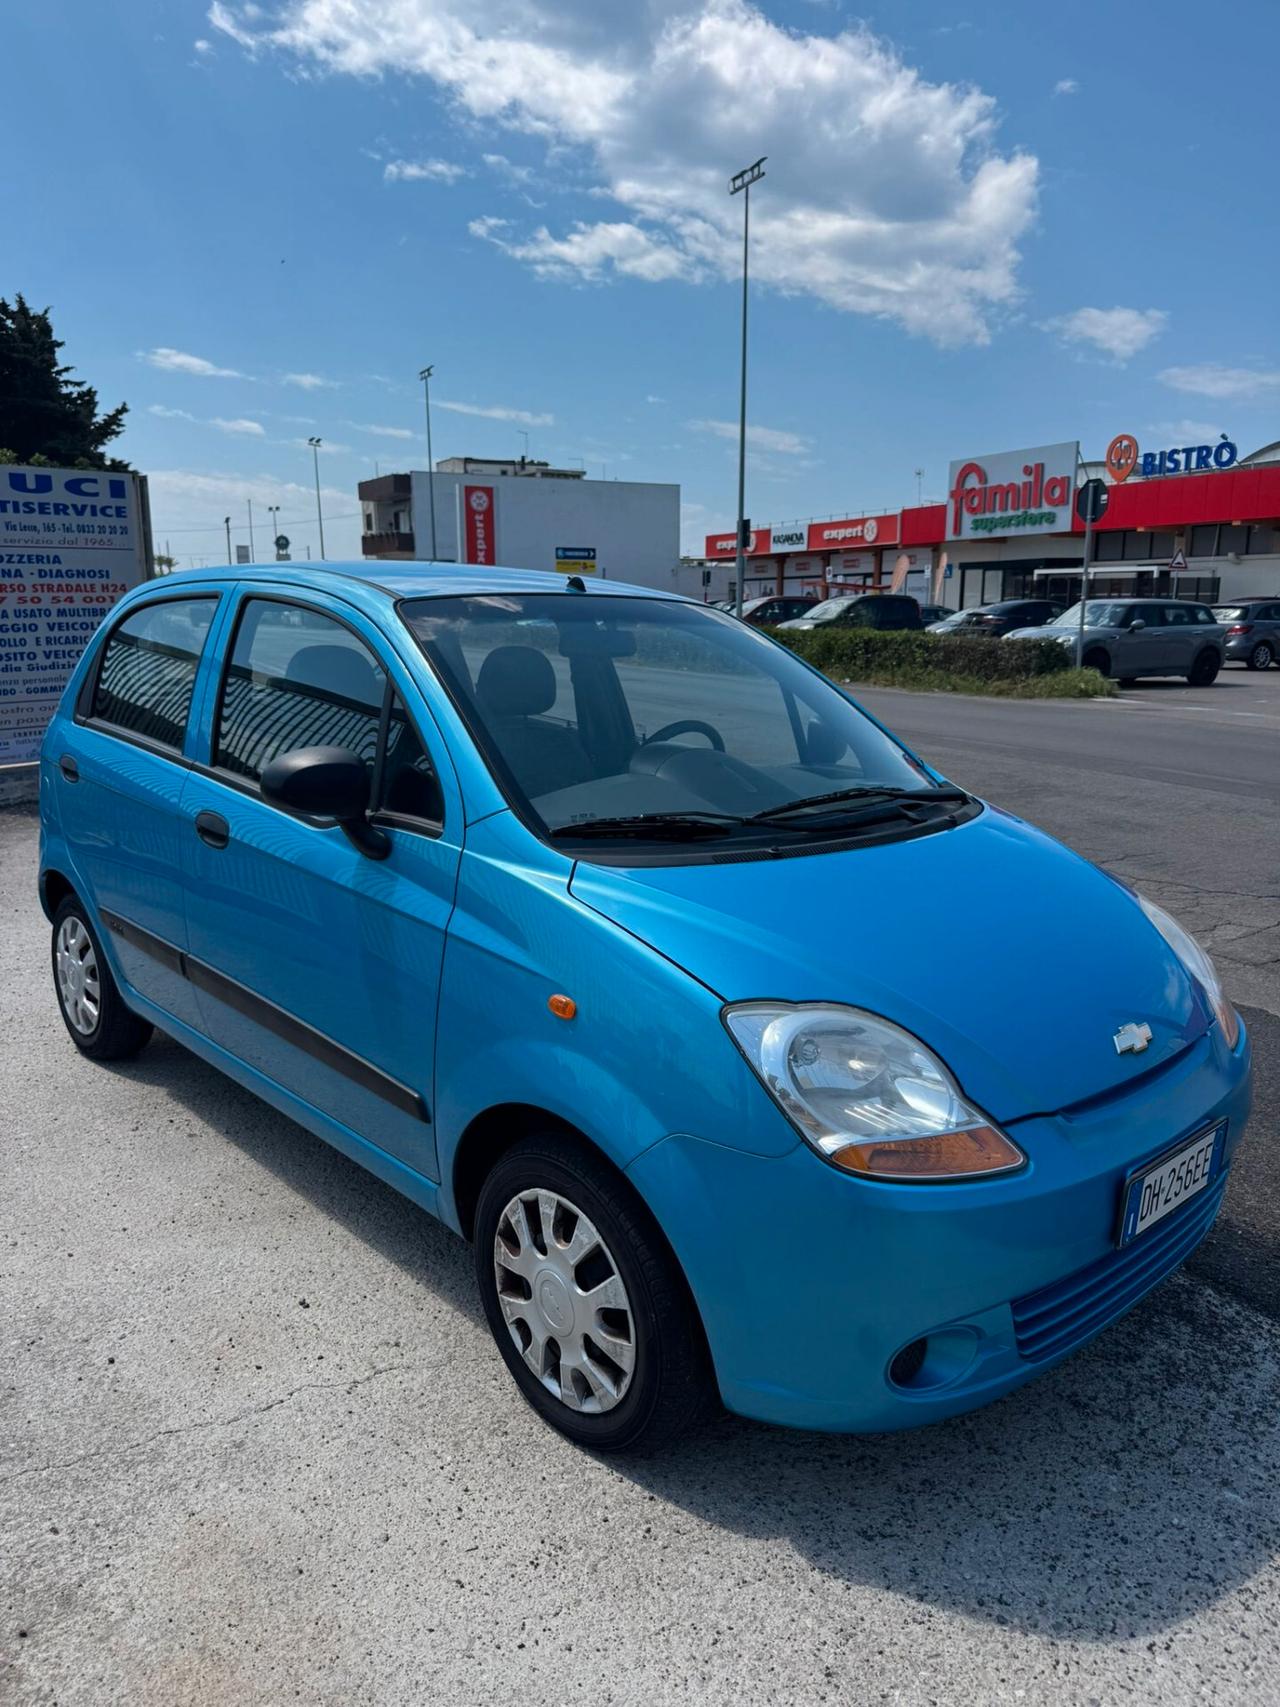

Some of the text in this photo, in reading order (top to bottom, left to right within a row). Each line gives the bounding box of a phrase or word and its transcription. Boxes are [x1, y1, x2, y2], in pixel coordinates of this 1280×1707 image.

[1142, 433, 1238, 477] BISTRÒ
[950, 462, 1071, 536] famila
[0, 500, 128, 518] TISERVICE
[970, 510, 1056, 533] superstore
[5, 521, 17, 532] Via
[19, 522, 40, 534] Lecce,
[42, 523, 56, 533] 165
[62, 523, 75, 533] Tel.
[823, 525, 863, 541] expert
[3, 537, 54, 545] servizio
[58, 537, 78, 546] dal
[38, 569, 110, 579] DIAGNOSI
[31, 583, 97, 593] STRADALE
[101, 583, 128, 593] H24
[17, 596, 42, 604] 50
[51, 596, 75, 604] 54
[82, 596, 116, 604] 001
[14, 608, 52, 619] USATO
[35, 637, 42, 646] E
[23, 675, 68, 685] personale
[0, 688, 16, 696] DO
